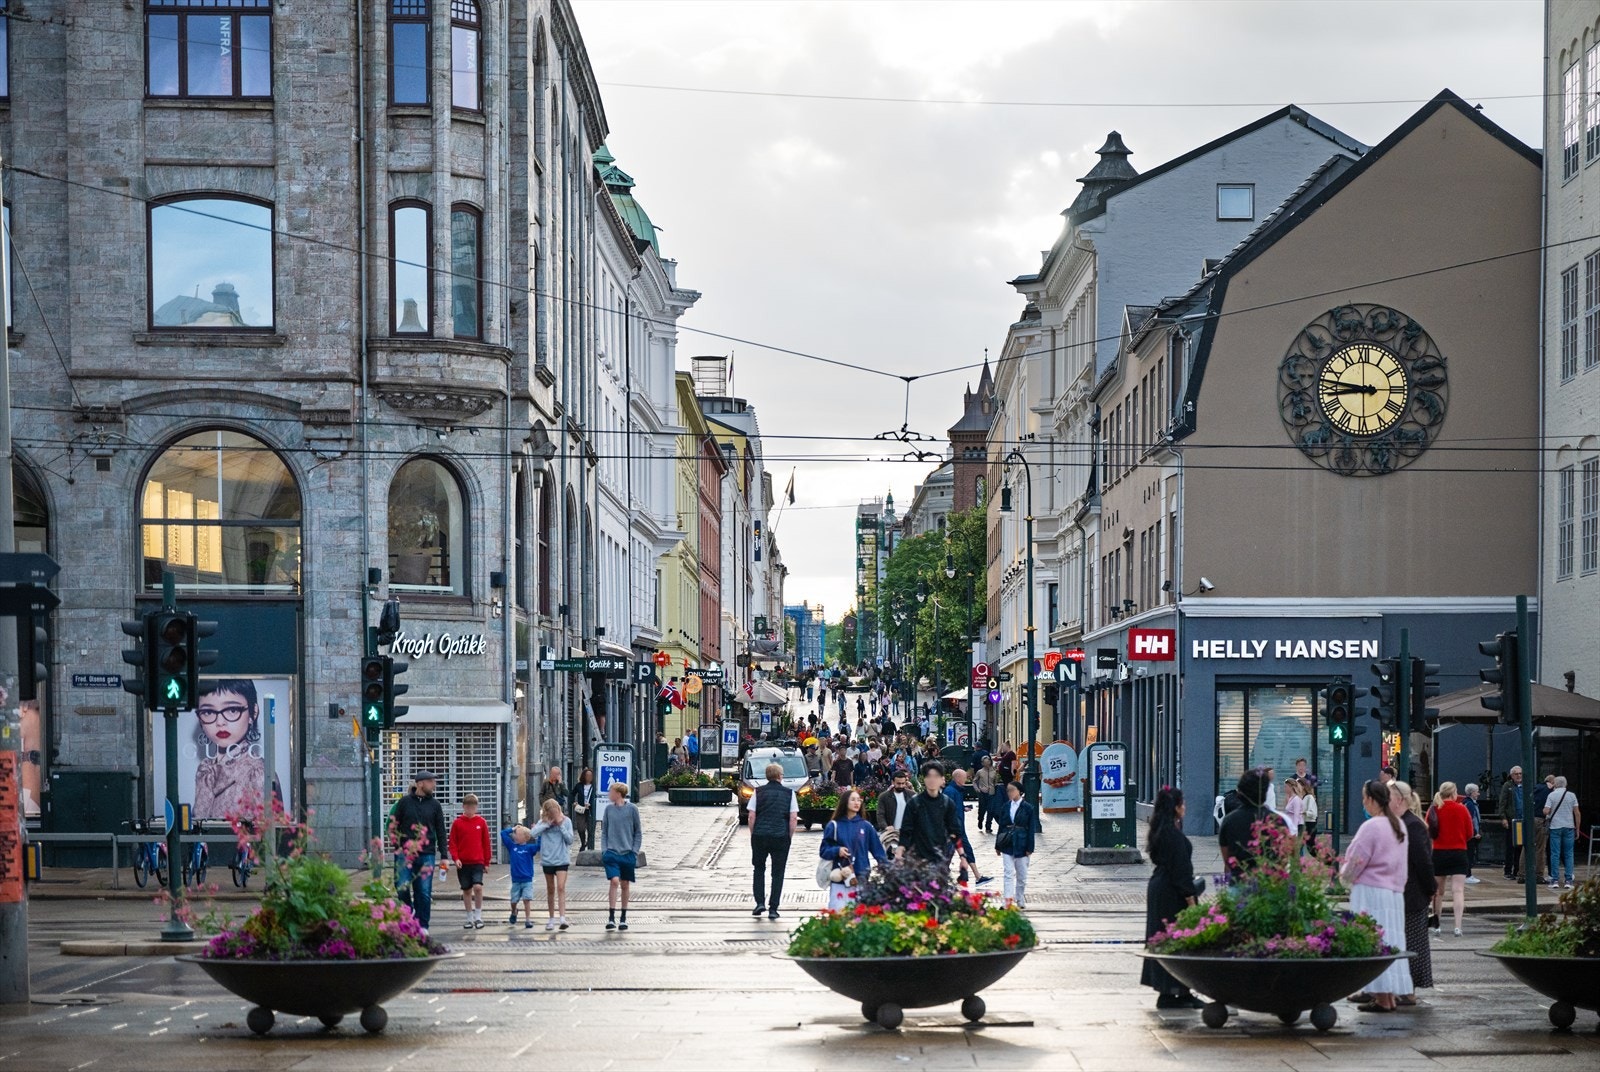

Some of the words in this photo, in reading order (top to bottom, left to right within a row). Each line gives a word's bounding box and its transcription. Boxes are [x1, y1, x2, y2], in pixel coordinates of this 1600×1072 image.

[220, 17, 231, 57] INFRA
[466, 31, 476, 70] INFRA
[391, 631, 435, 659] Krogh
[439, 632, 487, 659] Optikk
[1135, 635, 1169, 654] HH
[1192, 639, 1269, 659] HELLY
[1275, 639, 1379, 659] HANSEN
[588, 659, 611, 670] Optikk
[1059, 663, 1077, 682] N
[75, 675, 87, 683] Fred.
[88, 675, 106, 683] Olsens
[106, 676, 119, 684] gate
[603, 752, 626, 763] Sone
[1097, 752, 1119, 761] Sone
